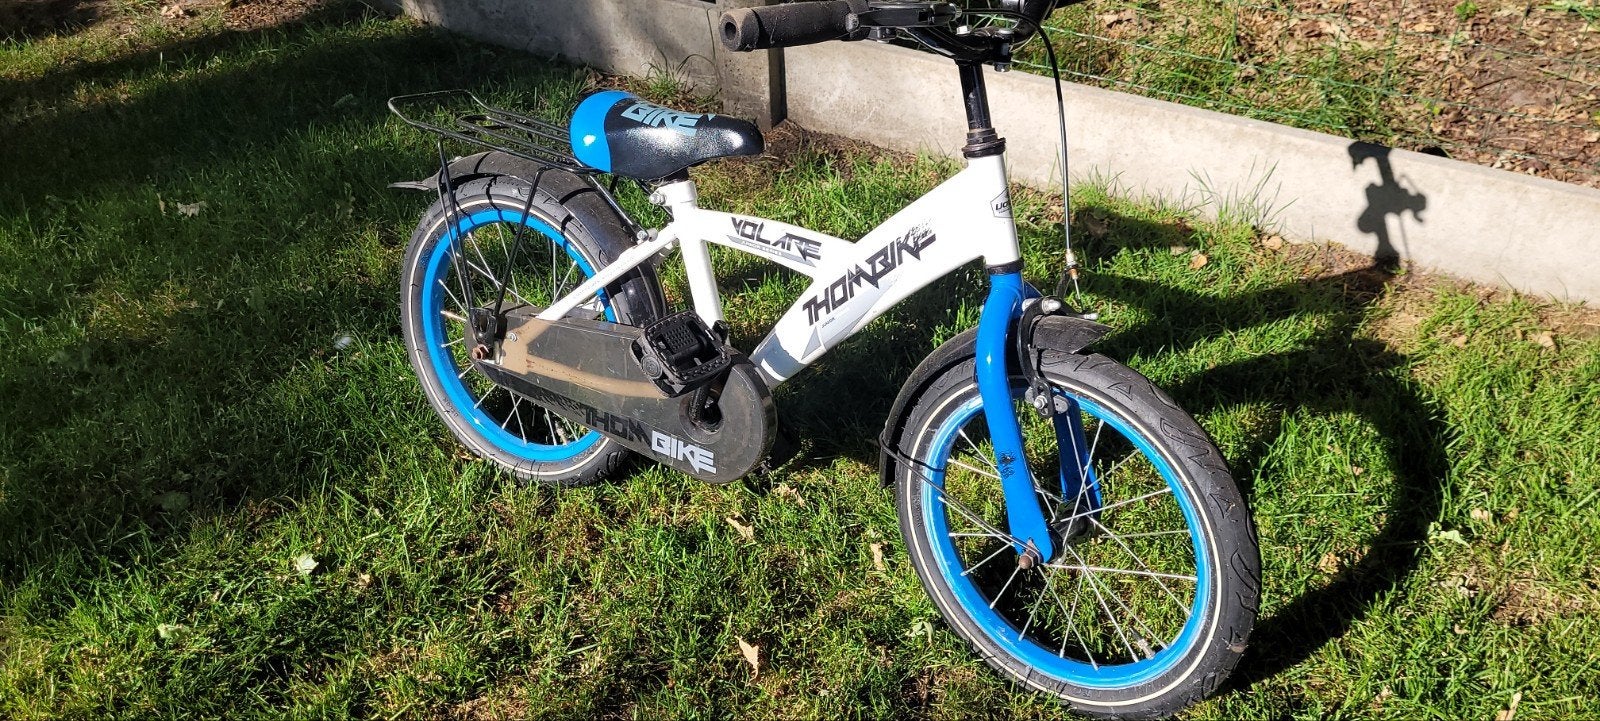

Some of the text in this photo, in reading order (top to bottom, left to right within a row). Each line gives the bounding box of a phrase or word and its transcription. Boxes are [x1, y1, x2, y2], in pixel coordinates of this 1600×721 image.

[621, 102, 702, 137] BIKE
[731, 217, 822, 261] VOLARE
[802, 231, 937, 326] THOMBIKE
